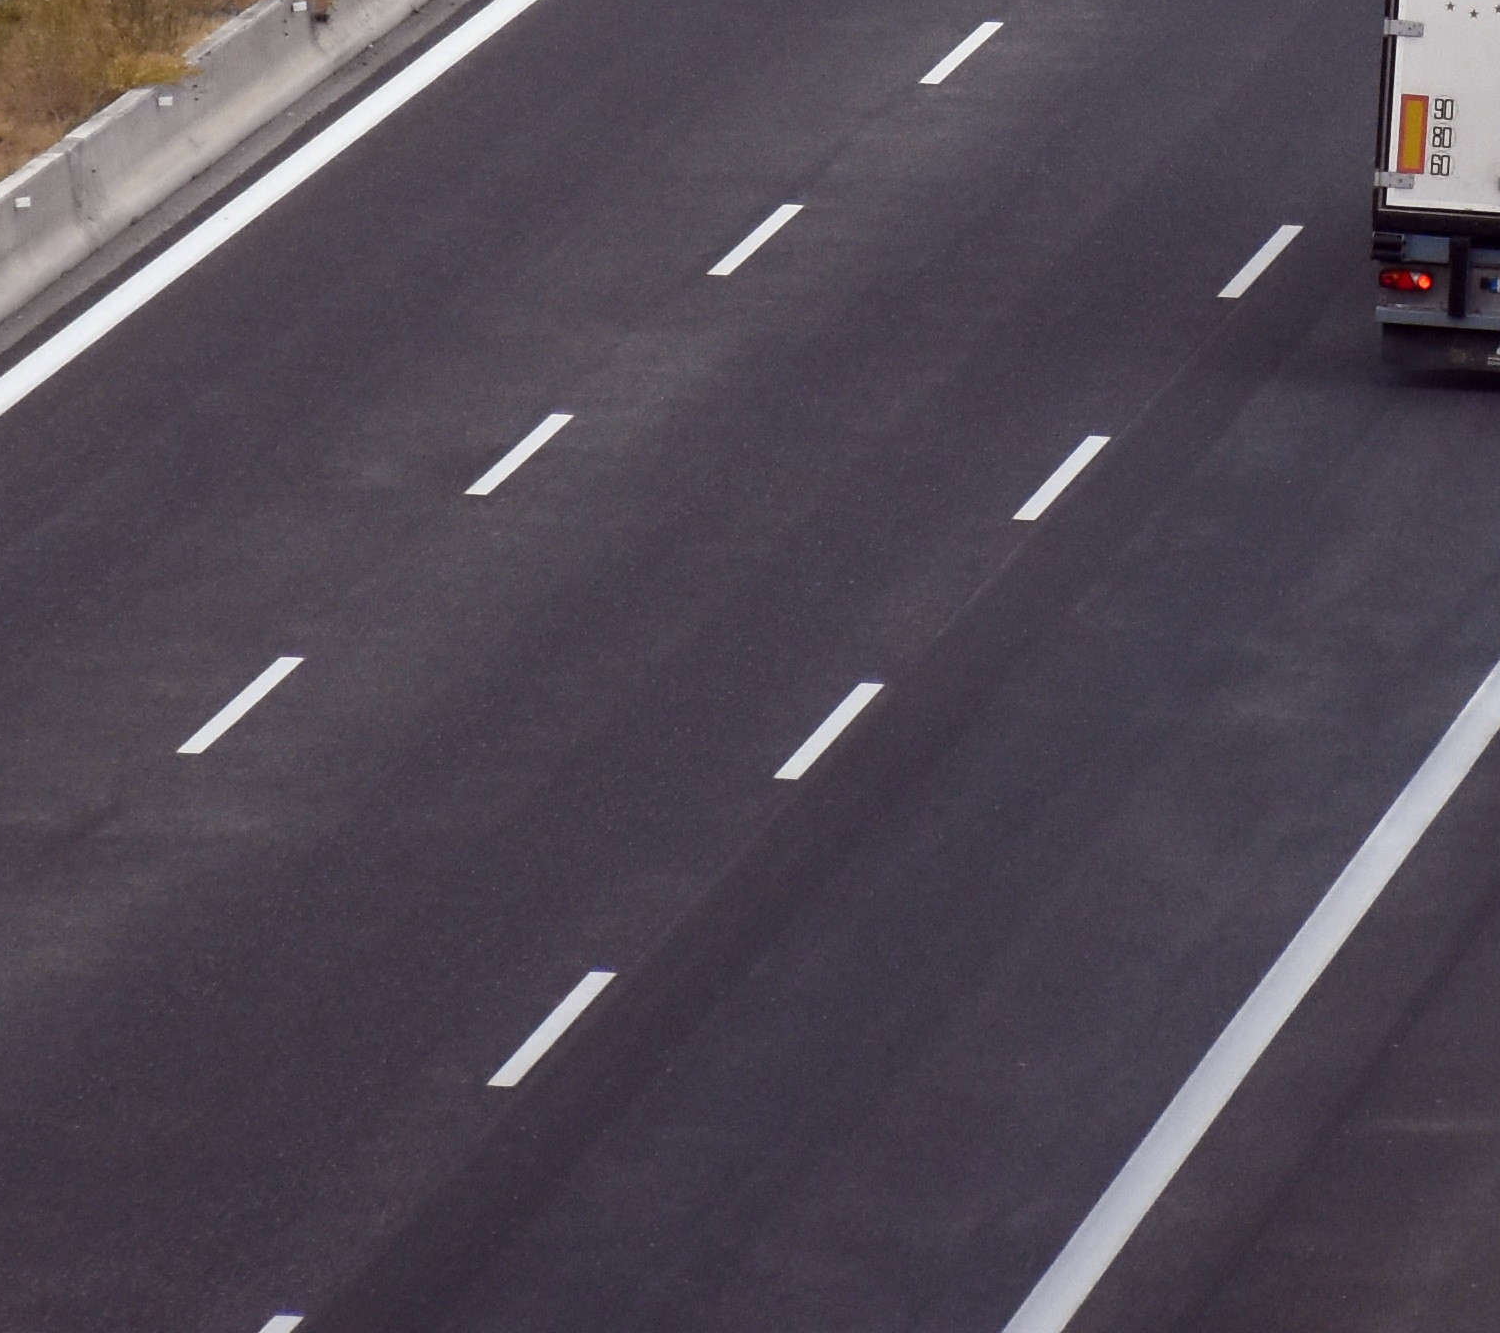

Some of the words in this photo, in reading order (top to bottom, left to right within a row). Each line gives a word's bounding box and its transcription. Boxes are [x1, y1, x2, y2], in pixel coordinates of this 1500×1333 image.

[1433, 98, 1454, 121] 90
[1432, 126, 1452, 149] 80
[1430, 153, 1451, 177] 60
